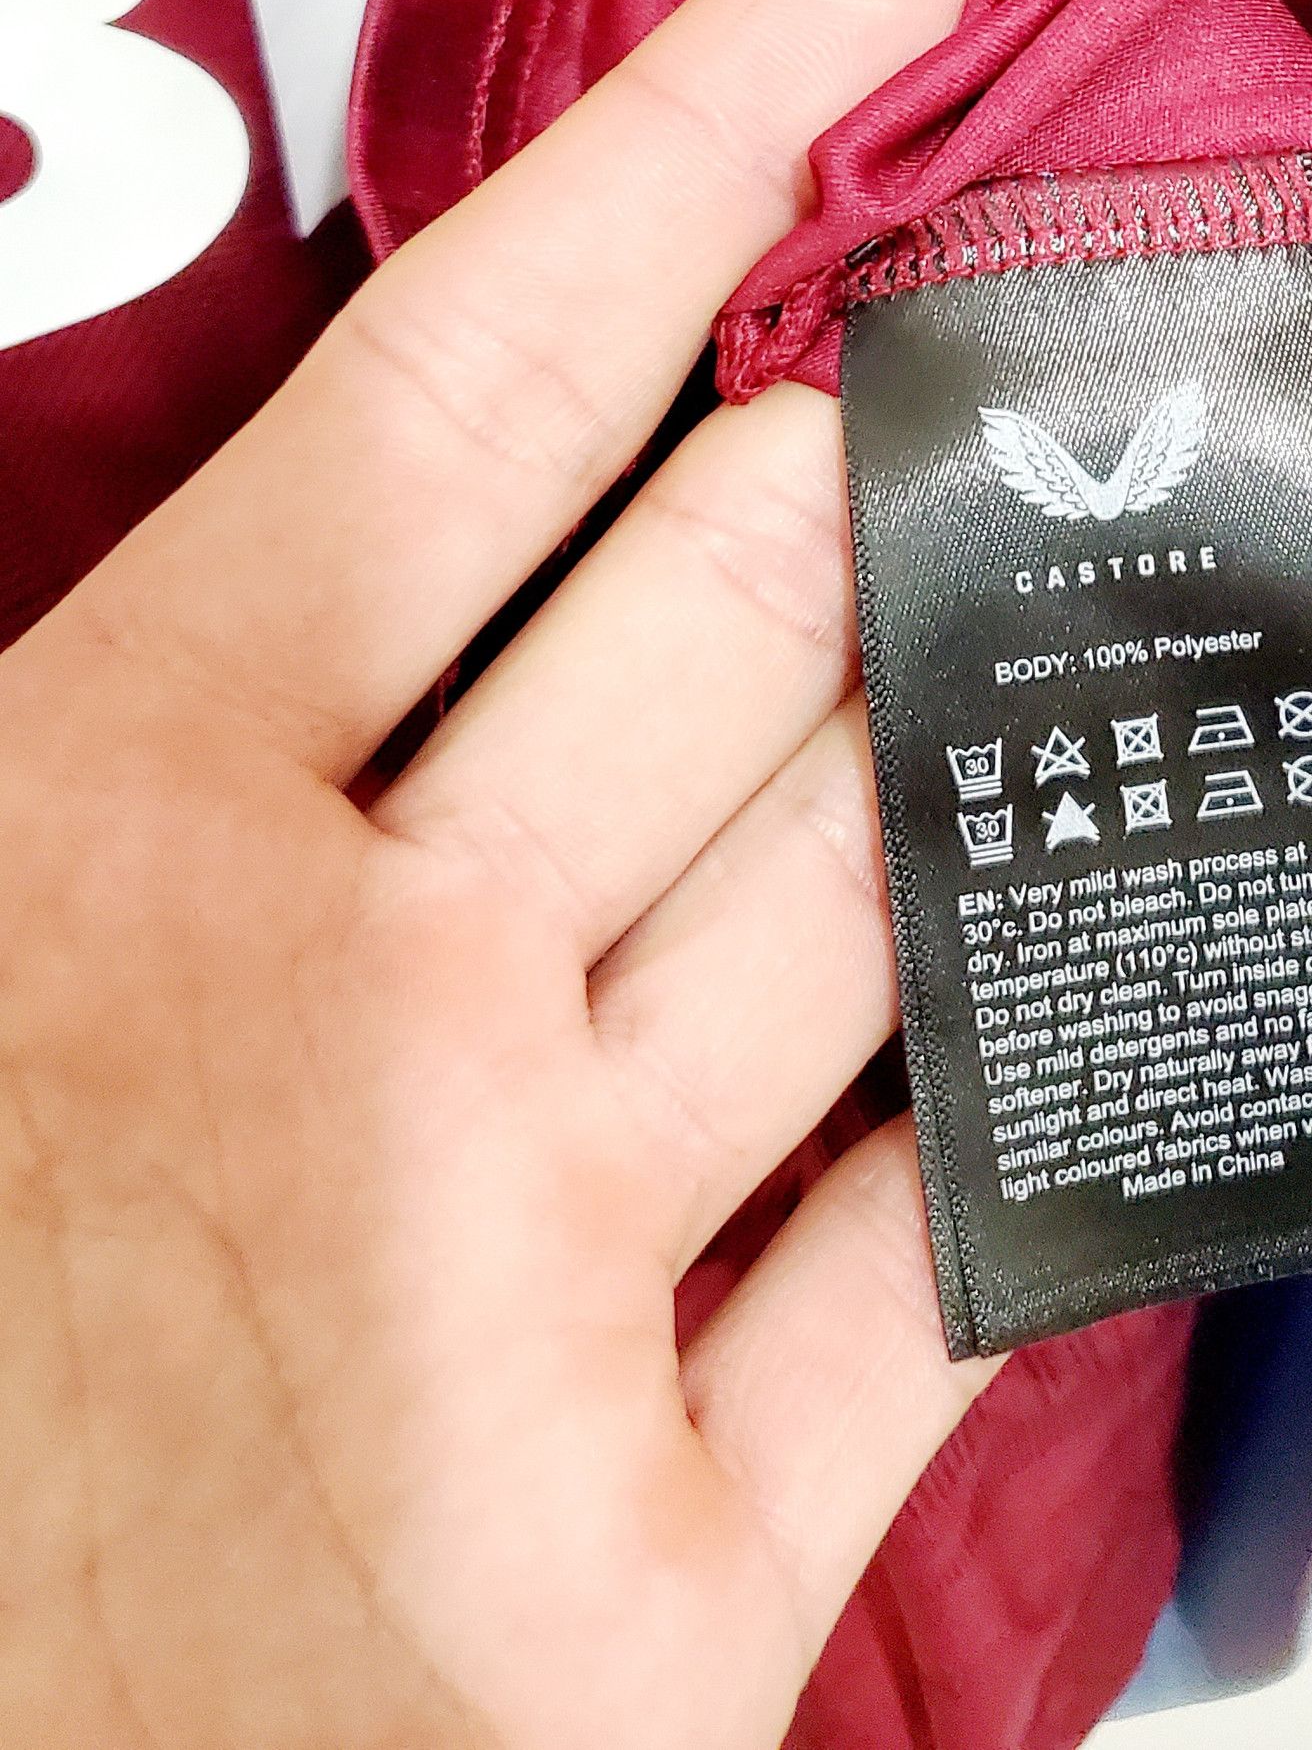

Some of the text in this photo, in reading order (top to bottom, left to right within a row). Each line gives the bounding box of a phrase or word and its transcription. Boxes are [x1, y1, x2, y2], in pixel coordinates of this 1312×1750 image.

[1015, 547, 1218, 594] CASTORE
[995, 630, 1262, 684] BODY: 100% Polyester
[965, 756, 990, 775] 30
[975, 819, 1000, 838] 30
[958, 841, 1308, 916] EN: Very mild wash process at
[1029, 910, 1063, 933] Do
[1069, 901, 1106, 925] not
[1110, 887, 1193, 917] bleach.
[1198, 882, 1232, 903] Do
[1238, 874, 1275, 898] not
[967, 950, 1011, 975] dry.
[1018, 940, 1062, 964] Iron
[1068, 931, 1091, 954] at
[1096, 917, 1206, 948] maximum
[1212, 905, 1259, 929] sole
[970, 960, 1109, 999] temperature
[1203, 927, 1286, 959] without
[976, 1007, 1009, 1030] Do
[1015, 995, 1053, 1022] not
[1058, 991, 1094, 1014] dry
[1100, 982, 1168, 1005] clean.
[1172, 967, 1227, 992] Turn
[1232, 956, 1299, 983] inside
[979, 1027, 1053, 1058] before
[1058, 1008, 1152, 1040] washing
[1158, 1003, 1181, 1023] to
[1186, 989, 1247, 1017] avoid
[984, 1061, 1031, 1085] Use
[1036, 1045, 1084, 1075] mild
[1090, 1027, 1209, 1065] detergents
[1215, 1016, 1258, 1042] and
[1264, 1014, 1293, 1034] no
[988, 1079, 1088, 1115] softener.
[1093, 1068, 1133, 1092] Dry
[1139, 1049, 1235, 1083] naturally
[1241, 1041, 1300, 1065] away
[992, 1104, 1083, 1143] sunlight
[1087, 1094, 1129, 1122] and
[1135, 1082, 1199, 1111] direct
[1202, 1072, 1260, 1100] heat.
[997, 1138, 1071, 1171] similar
[1077, 1121, 1165, 1151] colours.
[1170, 1101, 1234, 1131] Avoid
[1000, 1169, 1051, 1200] light
[1054, 1144, 1151, 1186] coloured
[1156, 1133, 1231, 1162] fabrics
[1235, 1121, 1297, 1146] when
[1122, 1150, 1285, 1198] Made in China
